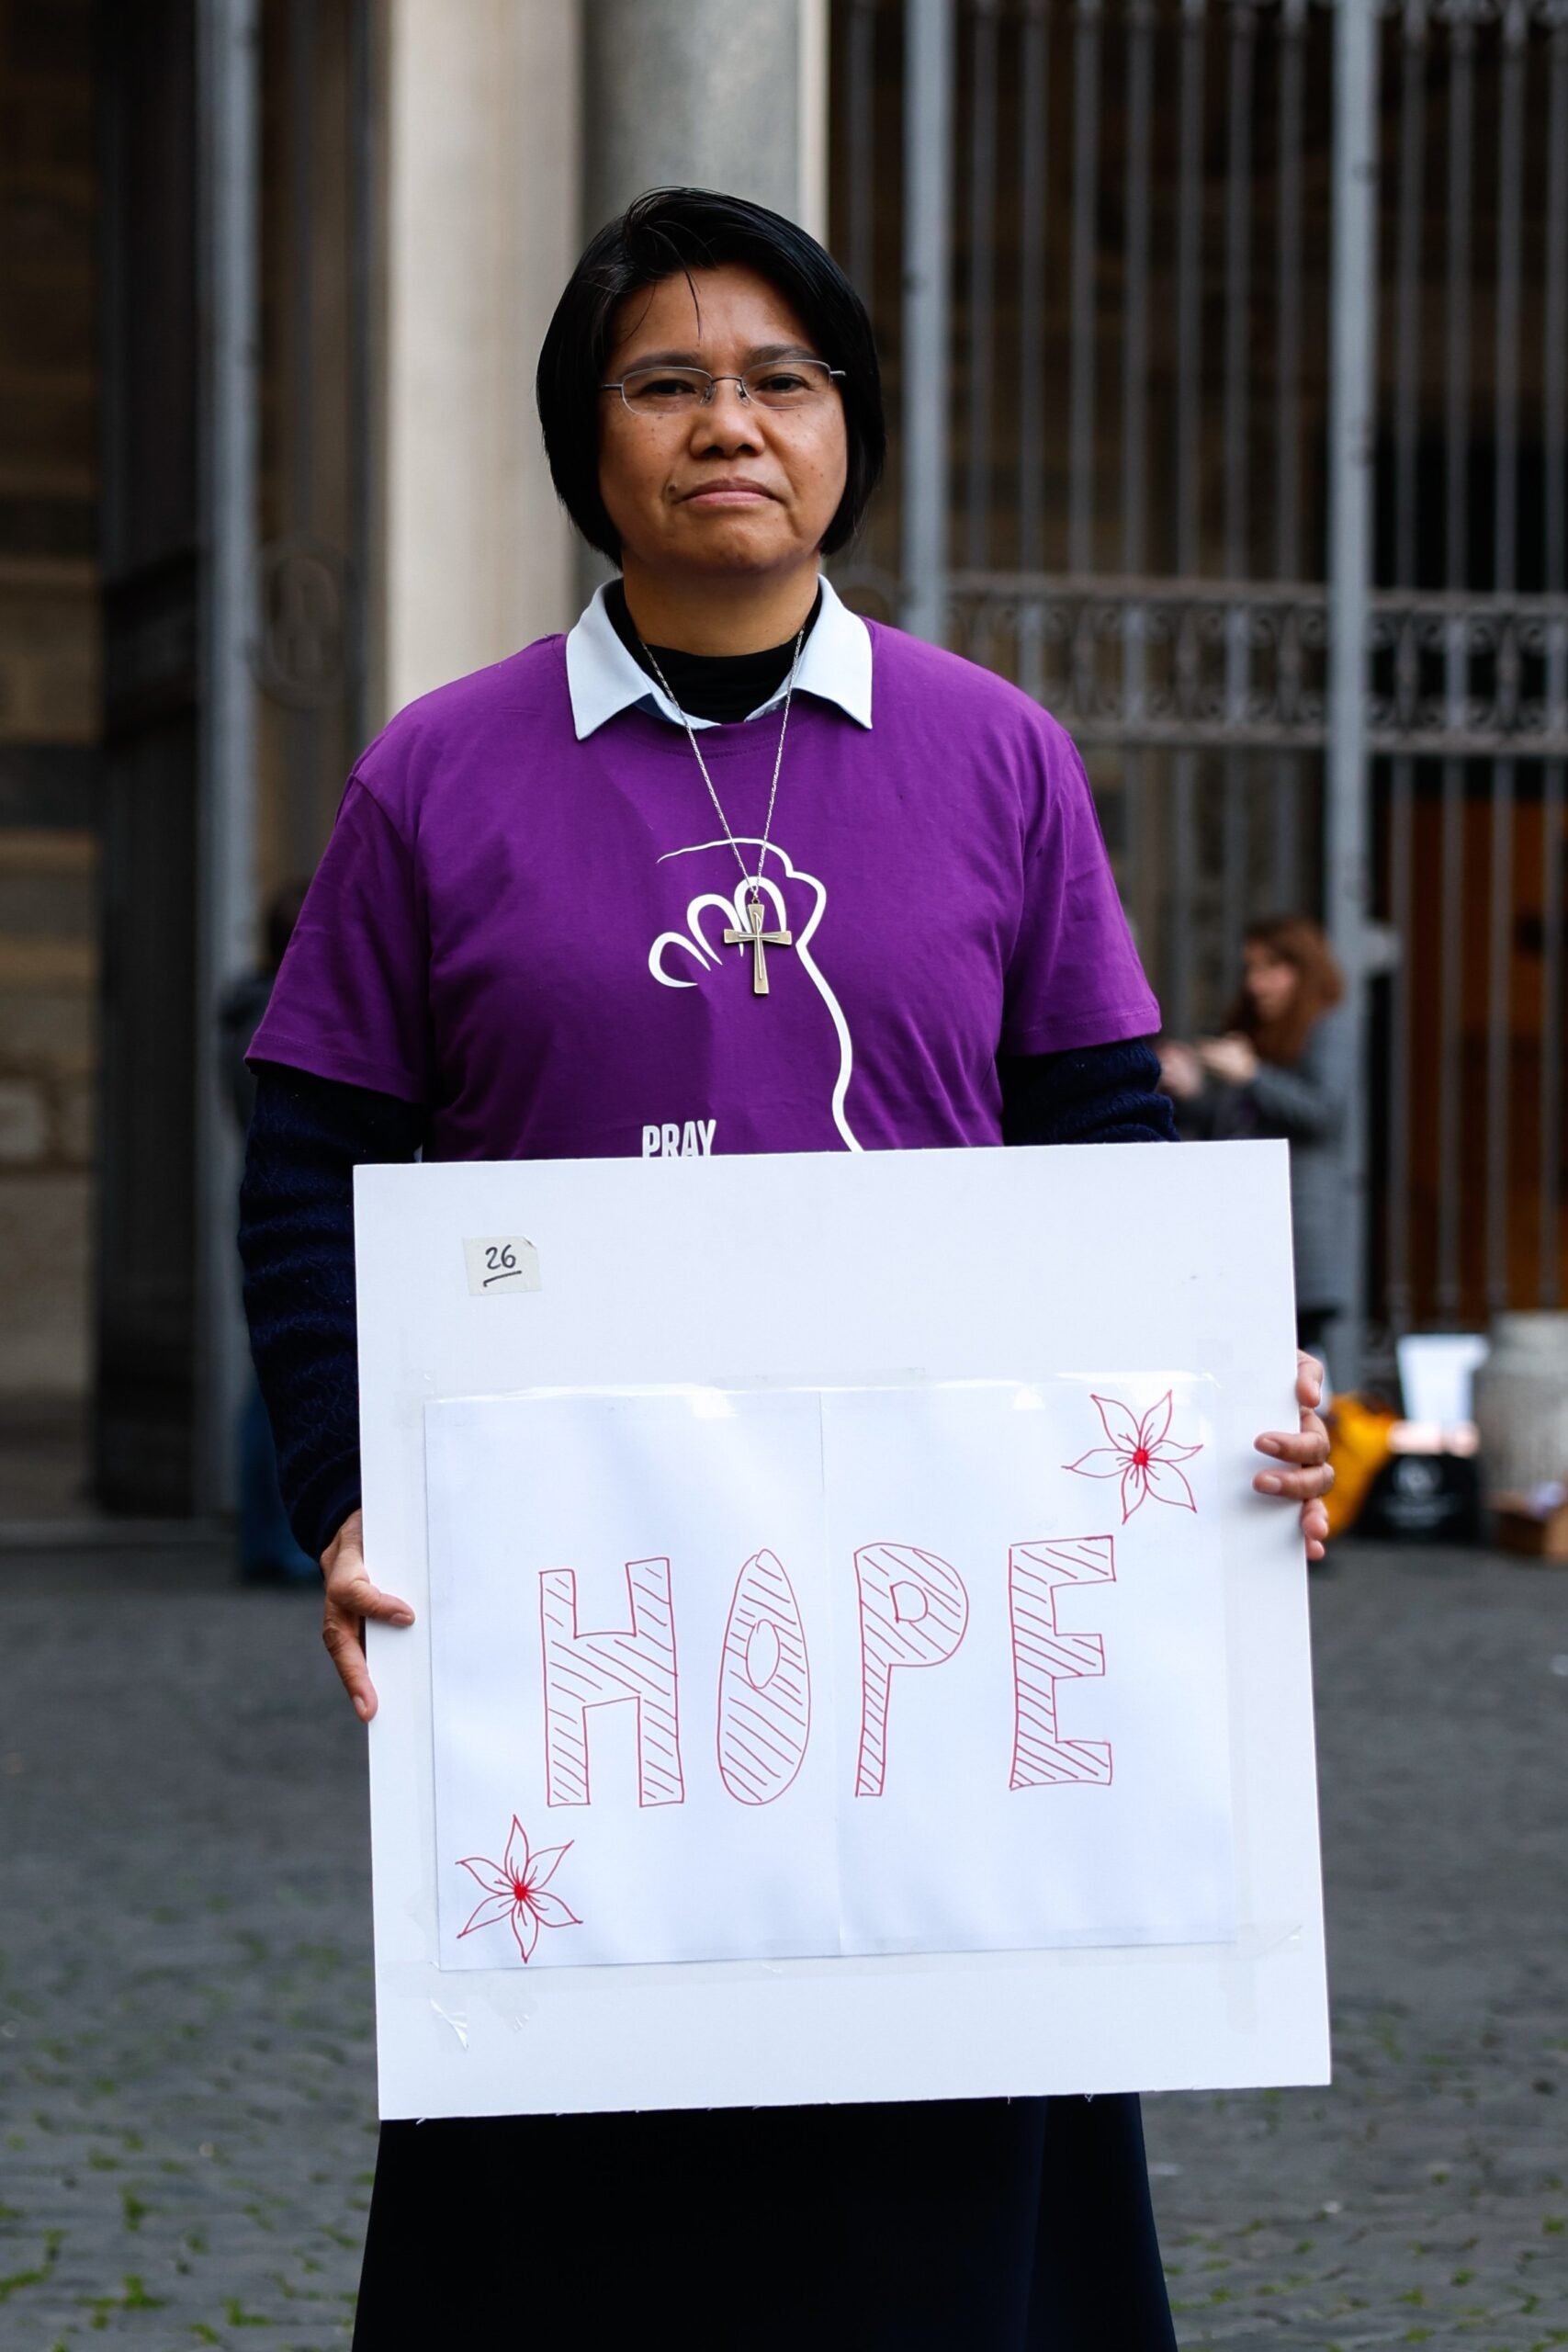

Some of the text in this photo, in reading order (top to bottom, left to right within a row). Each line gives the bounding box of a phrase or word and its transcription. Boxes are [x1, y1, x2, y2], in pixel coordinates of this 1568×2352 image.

[642, 1119, 716, 1158] PRAY
[485, 1244, 516, 1270] 26
[539, 1535, 1117, 1807] HOPE
